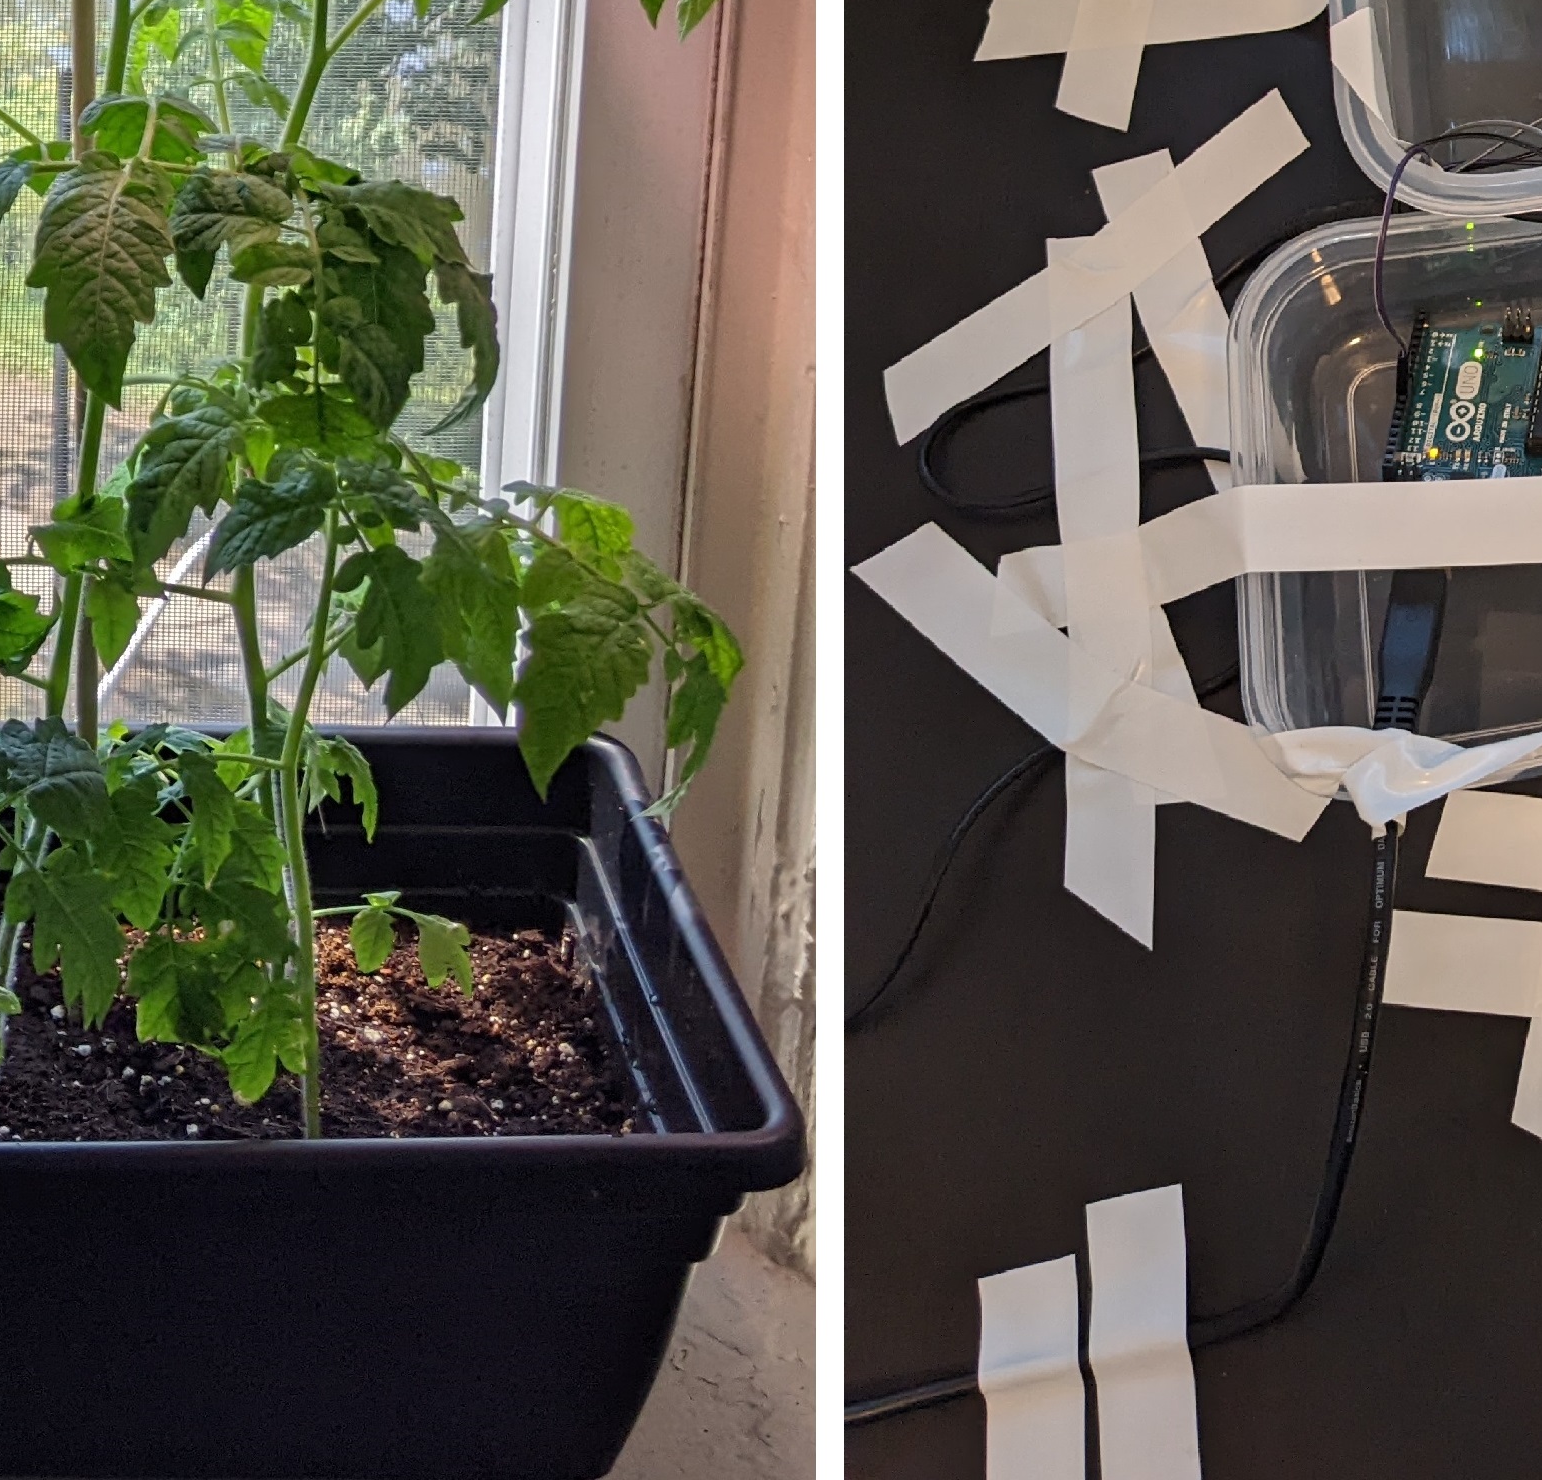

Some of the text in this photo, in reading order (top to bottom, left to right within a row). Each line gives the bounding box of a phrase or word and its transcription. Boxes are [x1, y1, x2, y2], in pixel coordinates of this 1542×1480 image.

[1459, 365, 1479, 395] UNO
[1472, 402, 1487, 442] ARDUINO
[1375, 861, 1385, 909] OPTIMUM
[1373, 920, 1381, 944] FOR
[1368, 955, 1378, 991] CABLE
[1359, 1031, 1370, 1052] USB
